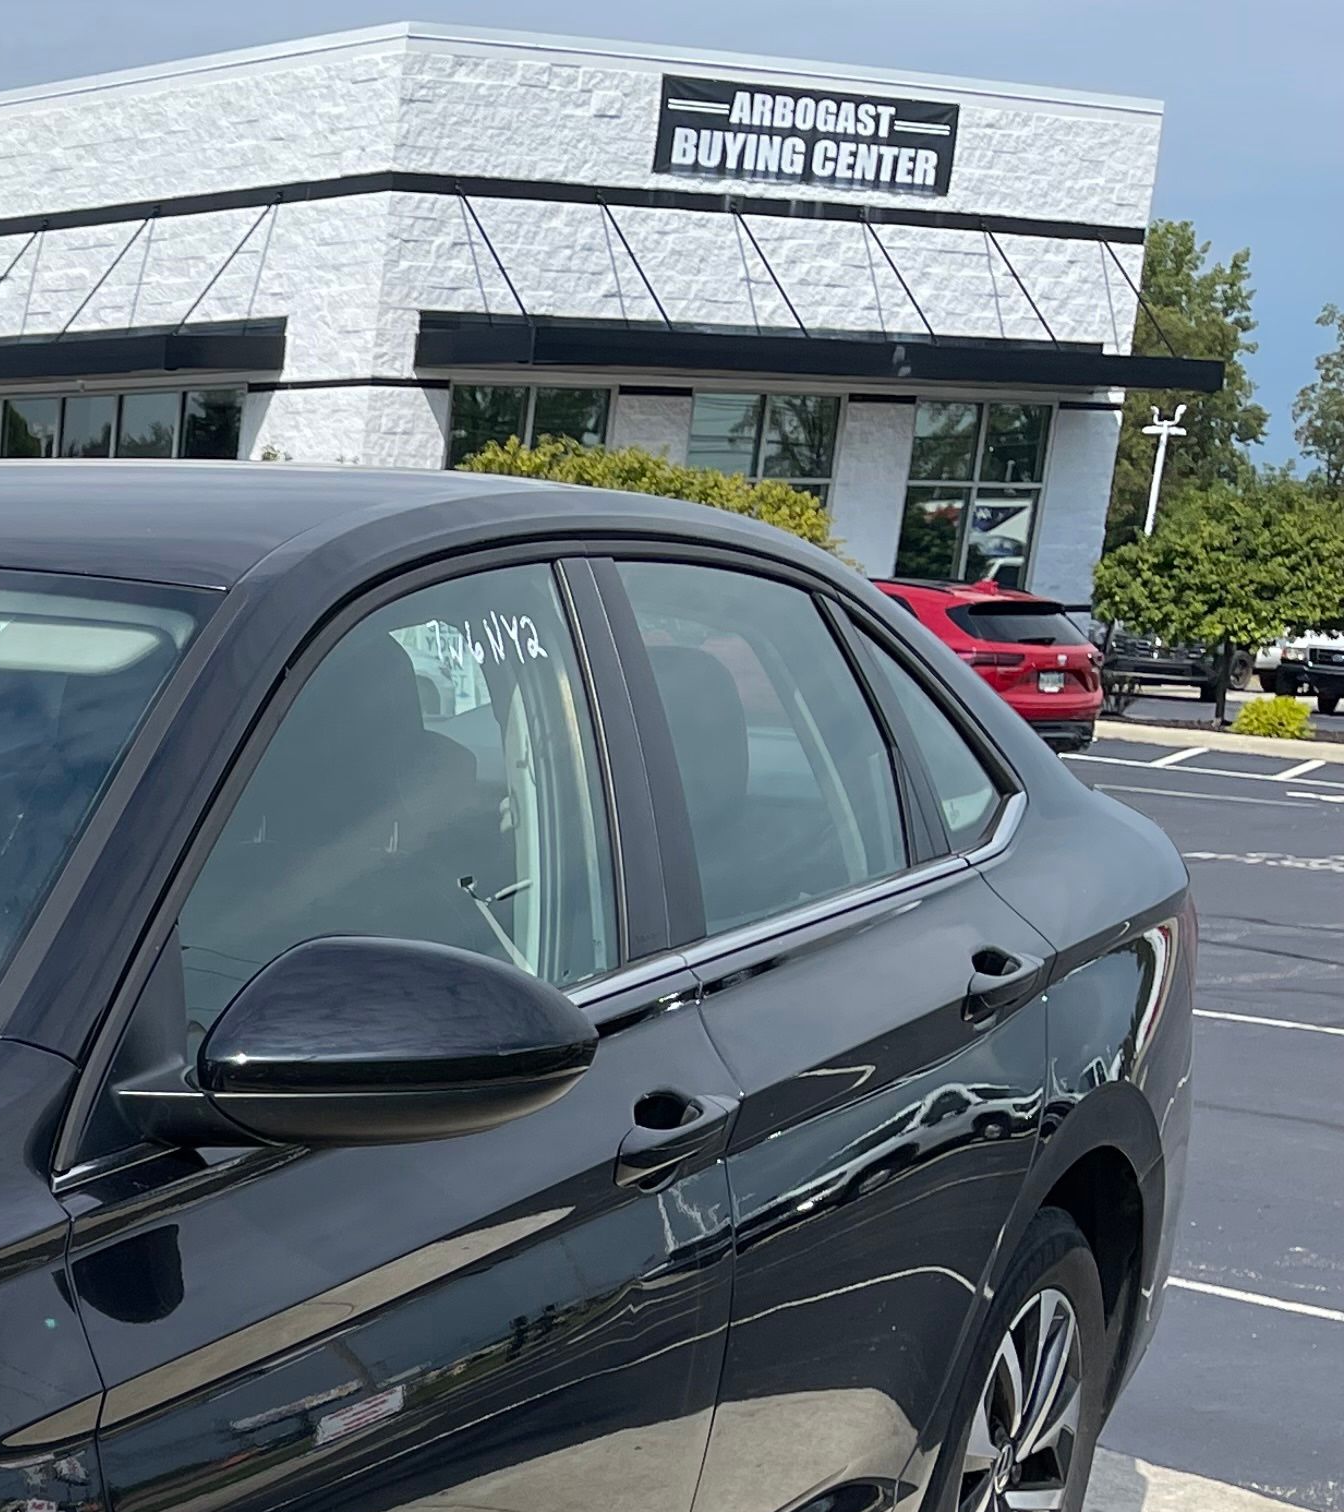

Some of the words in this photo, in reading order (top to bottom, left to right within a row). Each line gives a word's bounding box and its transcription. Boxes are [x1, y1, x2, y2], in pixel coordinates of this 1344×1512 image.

[728, 91, 896, 138] ARBOGAST
[670, 126, 806, 175] BUYING
[811, 139, 938, 185] CENTER
